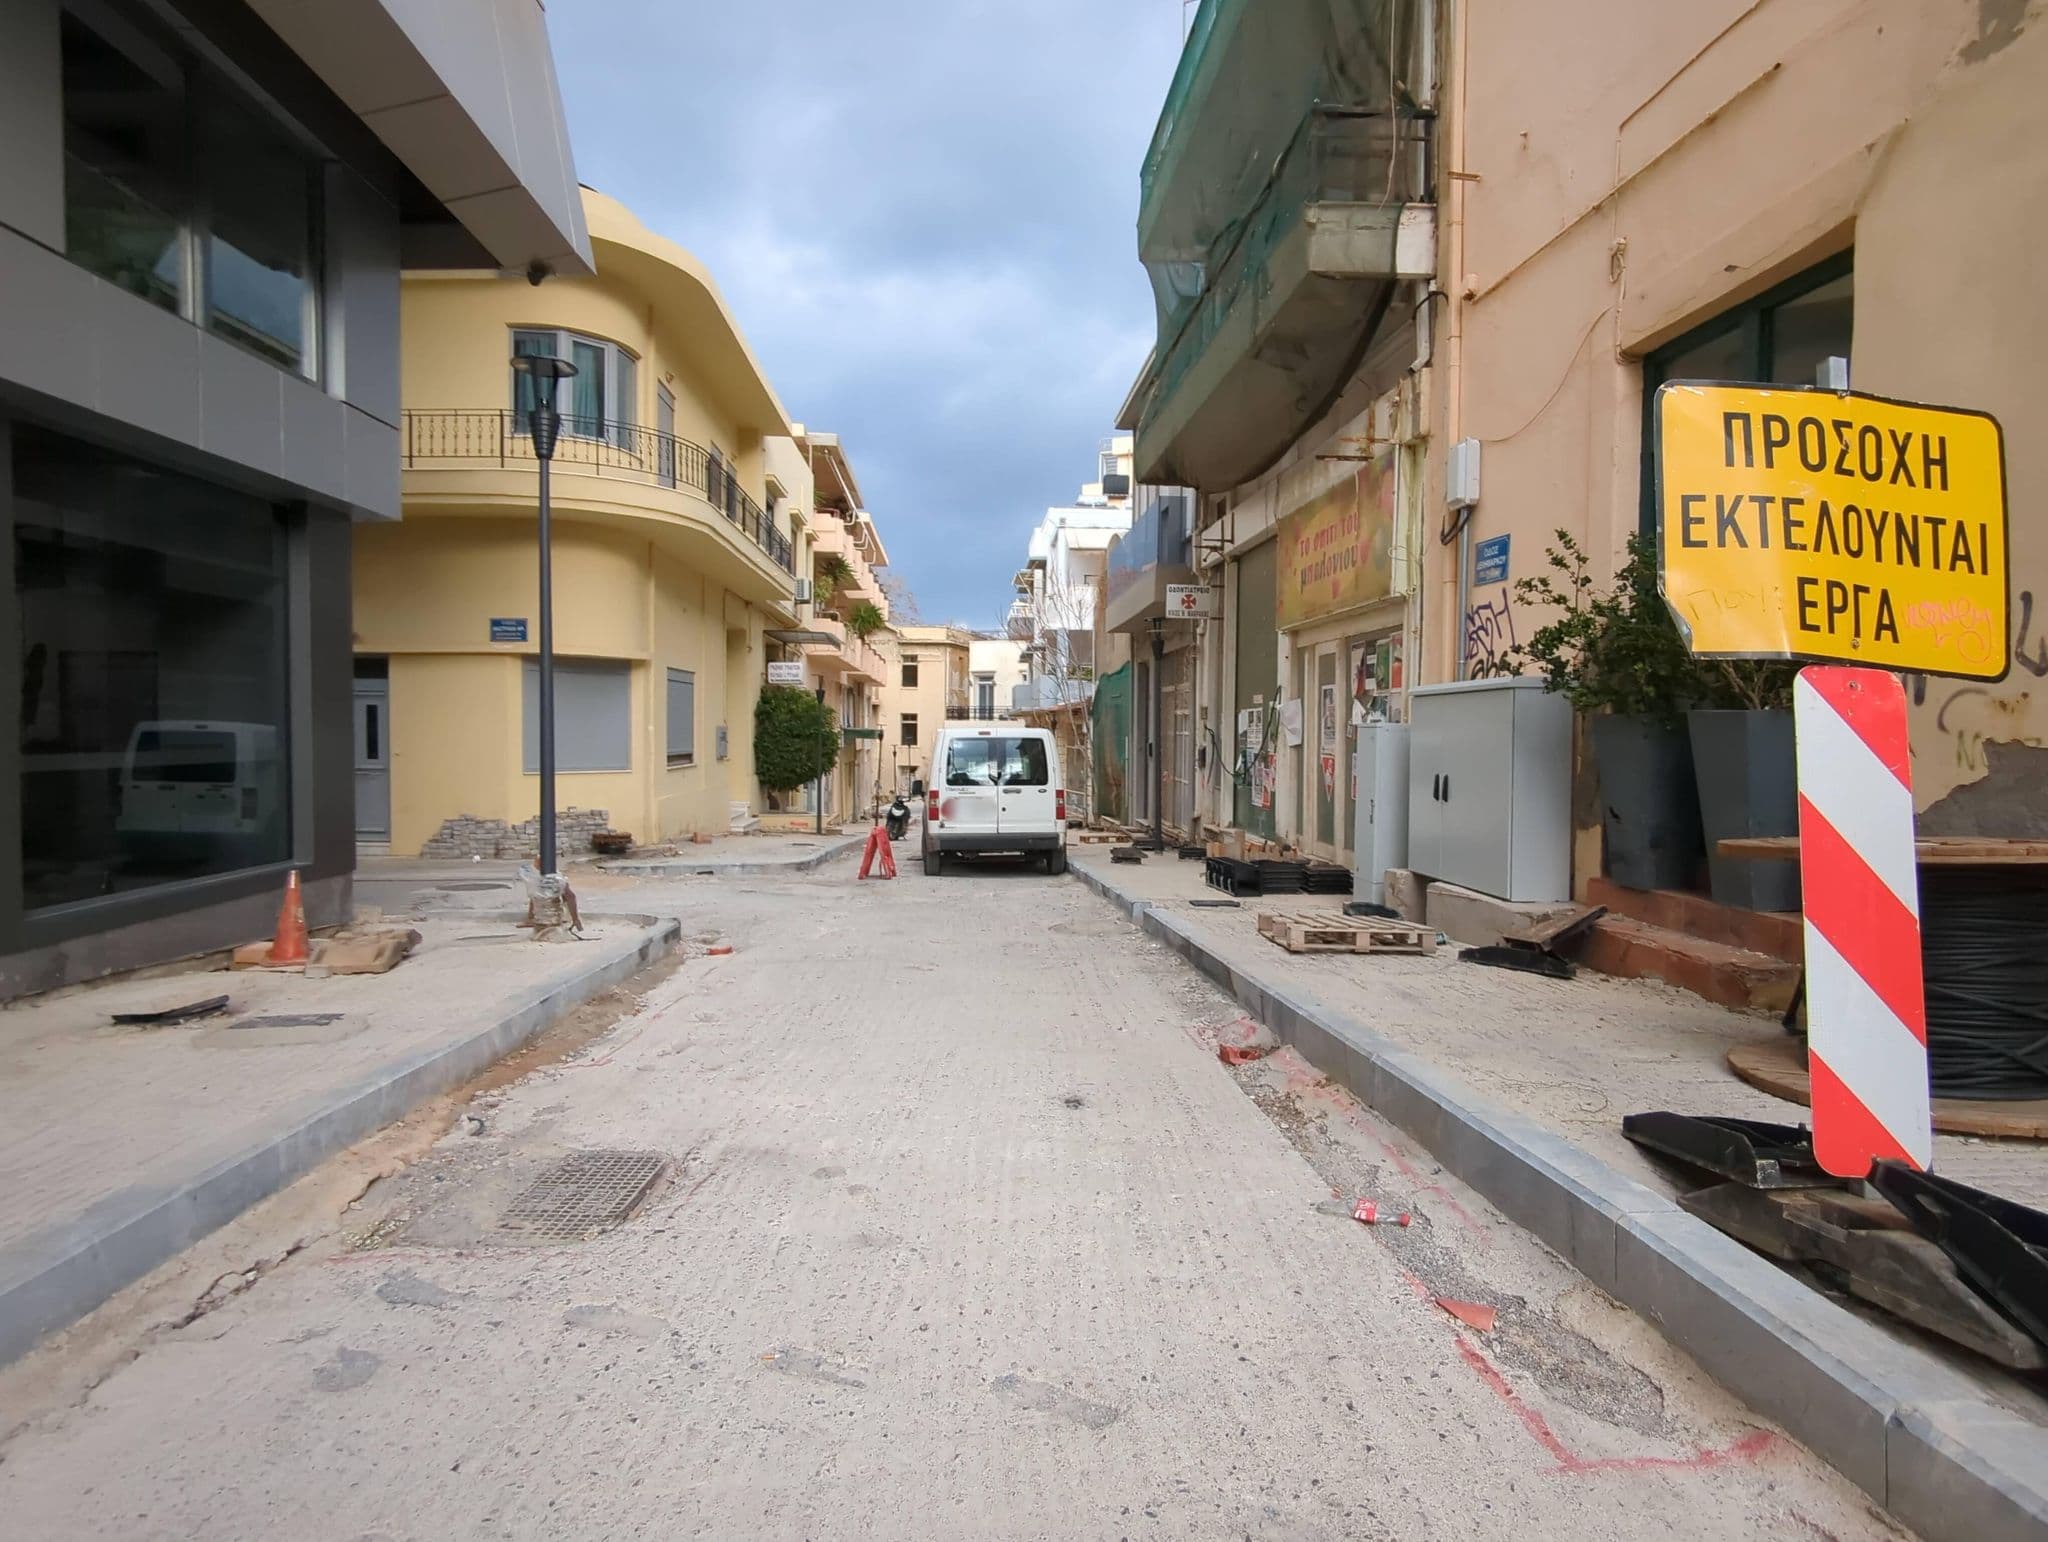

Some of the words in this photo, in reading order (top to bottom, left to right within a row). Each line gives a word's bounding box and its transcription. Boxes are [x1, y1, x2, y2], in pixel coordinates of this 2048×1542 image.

[1722, 411, 1949, 491] ΠΡΟΣΟΧΗ
[1680, 494, 1989, 576] ΕΚΤΕΛΟΥΝΤΑΙ
[1796, 576, 1900, 644] ΕΡΓΑ
